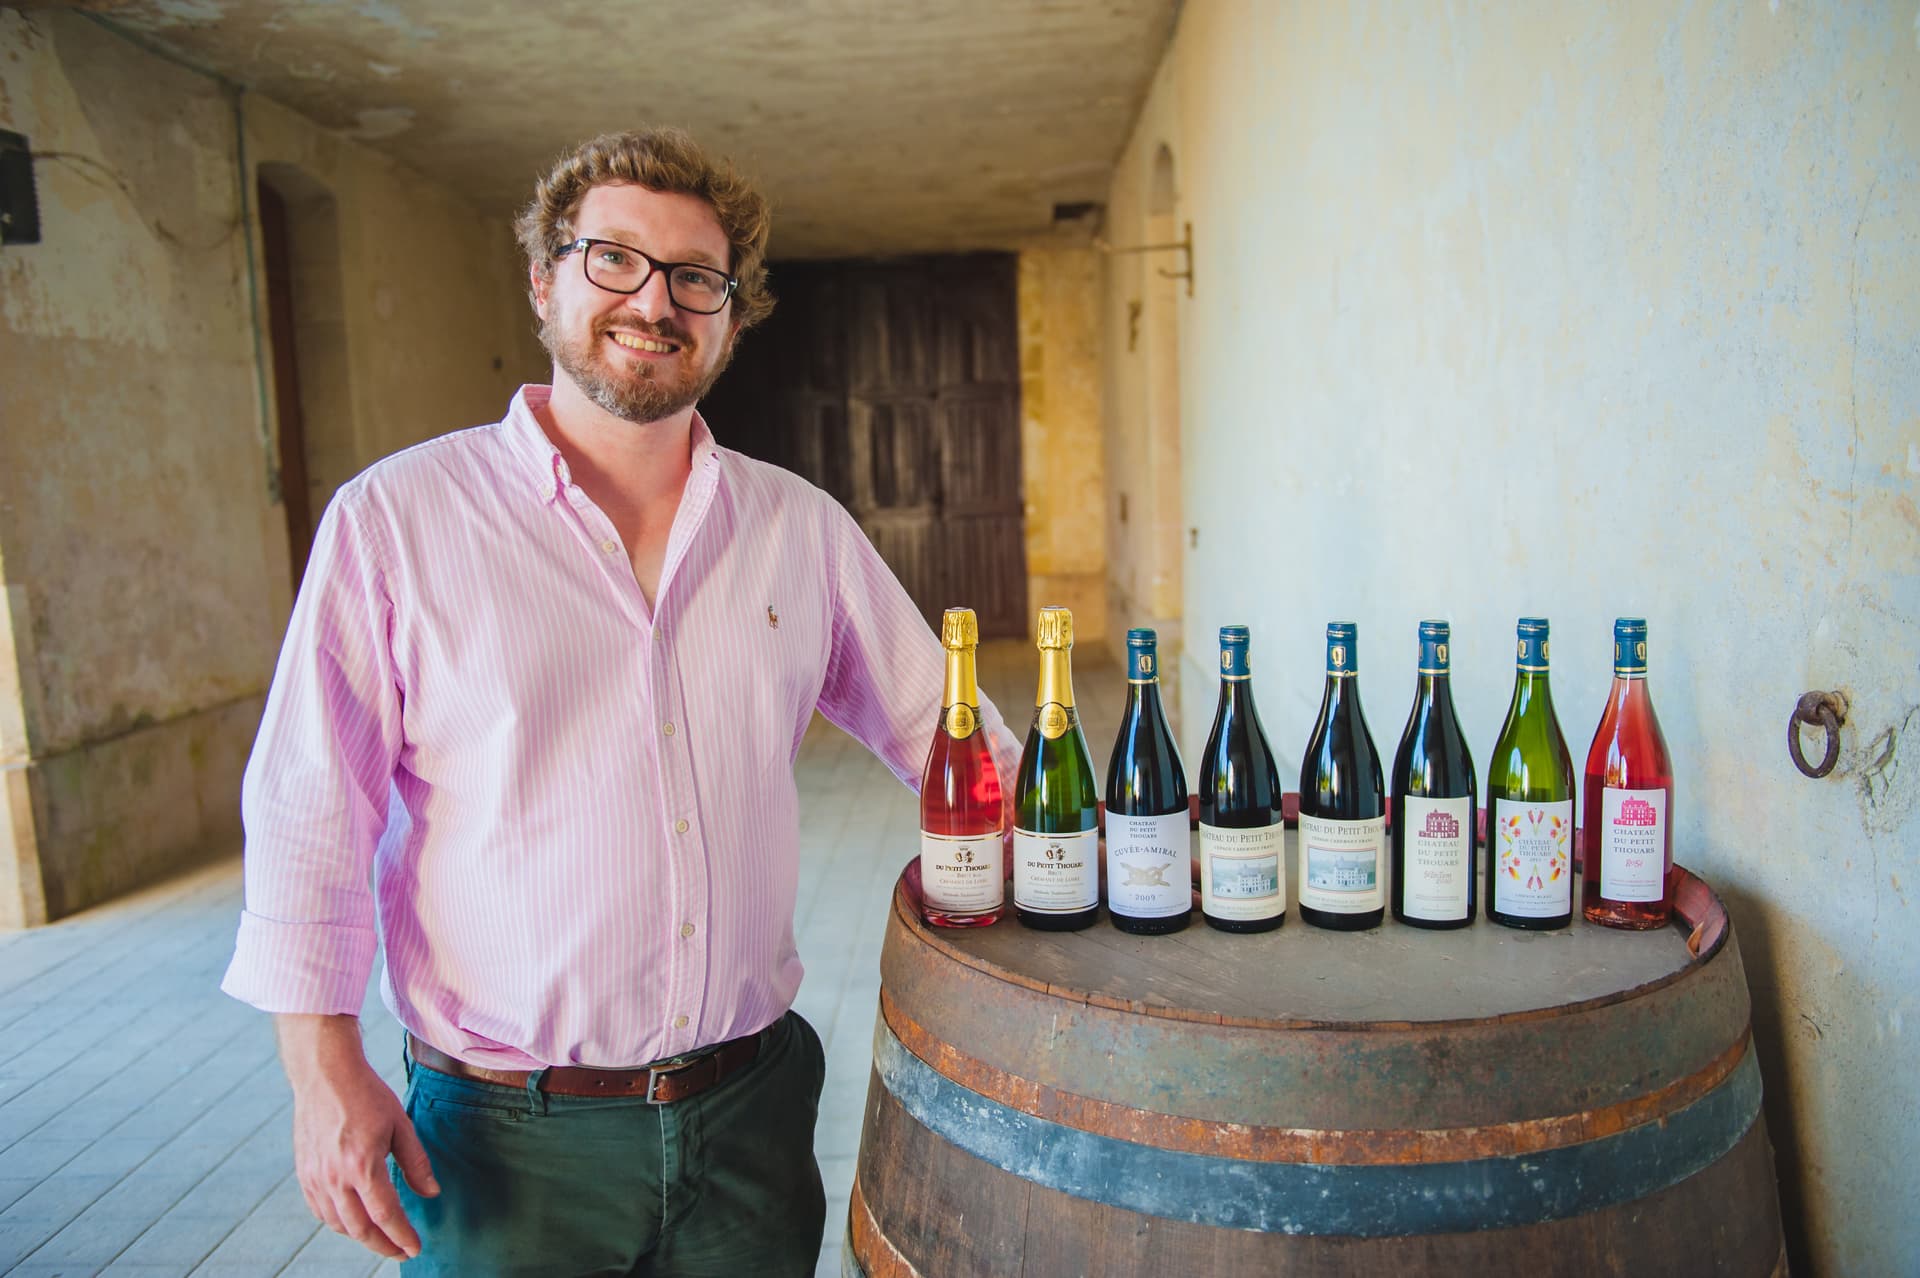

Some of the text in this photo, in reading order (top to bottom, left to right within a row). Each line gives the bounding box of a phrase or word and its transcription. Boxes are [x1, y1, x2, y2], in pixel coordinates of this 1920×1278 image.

[1324, 825, 1336, 834] DU
[1338, 826, 1360, 835] PETIT
[1227, 835, 1239, 843] DU
[1241, 833, 1264, 843] PETIT
[1418, 858, 1459, 866] THOUARS
